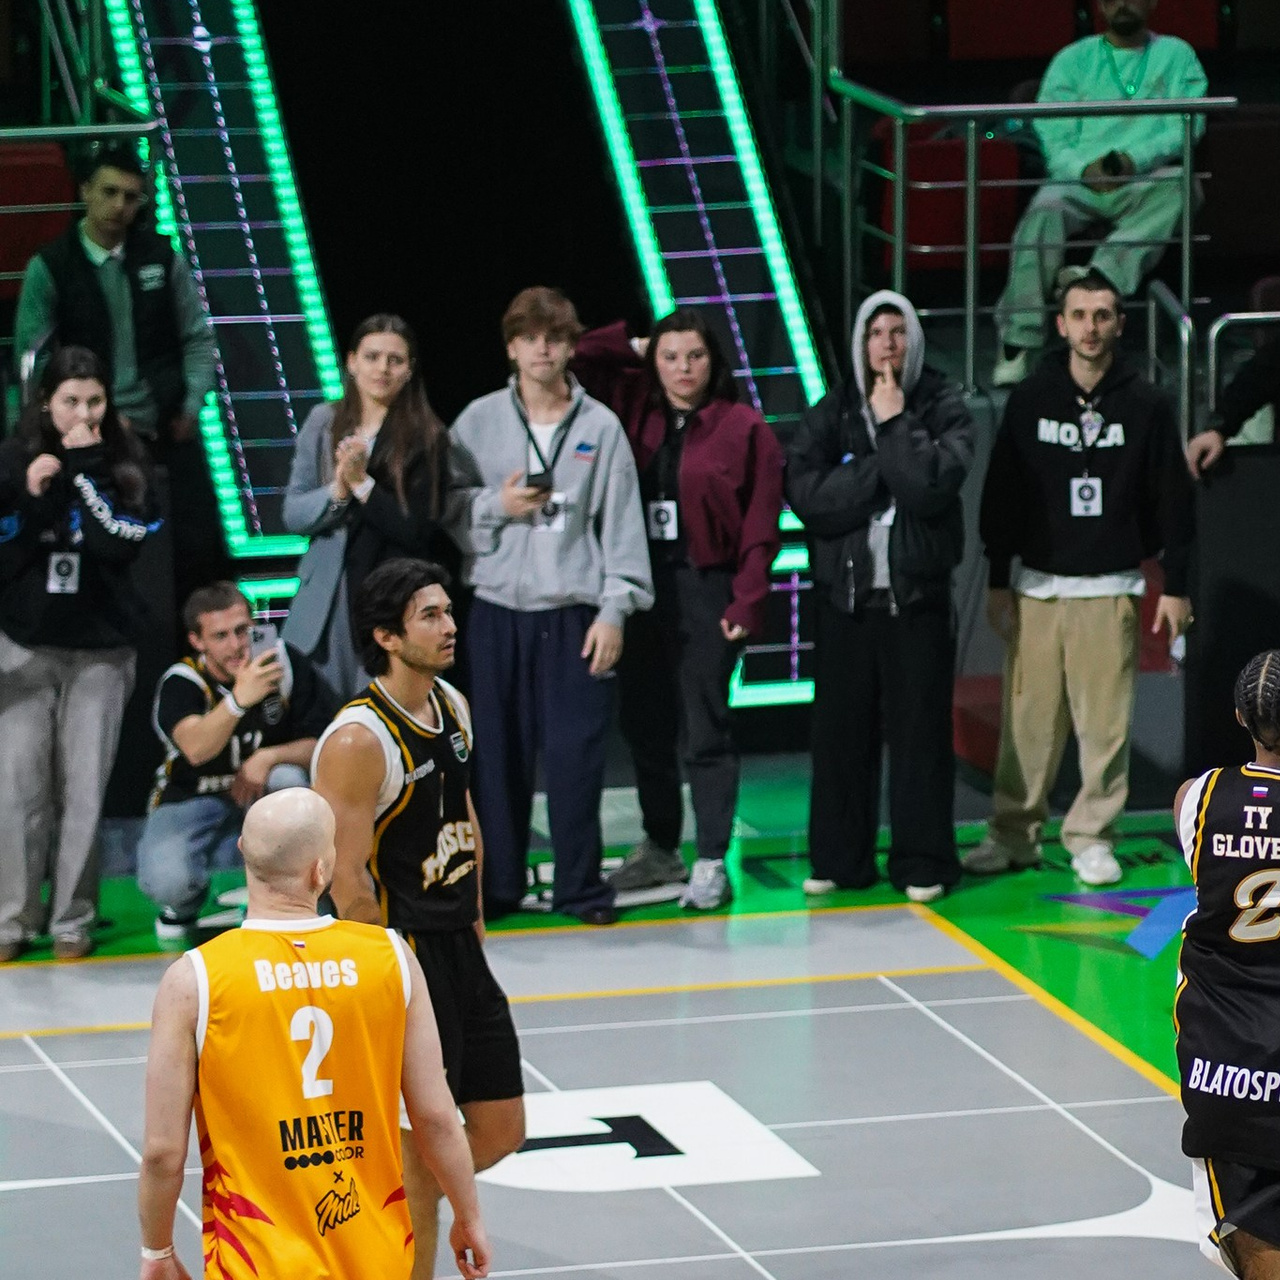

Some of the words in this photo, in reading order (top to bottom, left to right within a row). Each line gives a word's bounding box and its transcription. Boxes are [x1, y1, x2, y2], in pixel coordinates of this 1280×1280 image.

[1243, 806, 1273, 831] TY
[255, 958, 358, 992] Beaves
[290, 1005, 335, 1100] 2
[279, 1109, 365, 1153] MASTER
